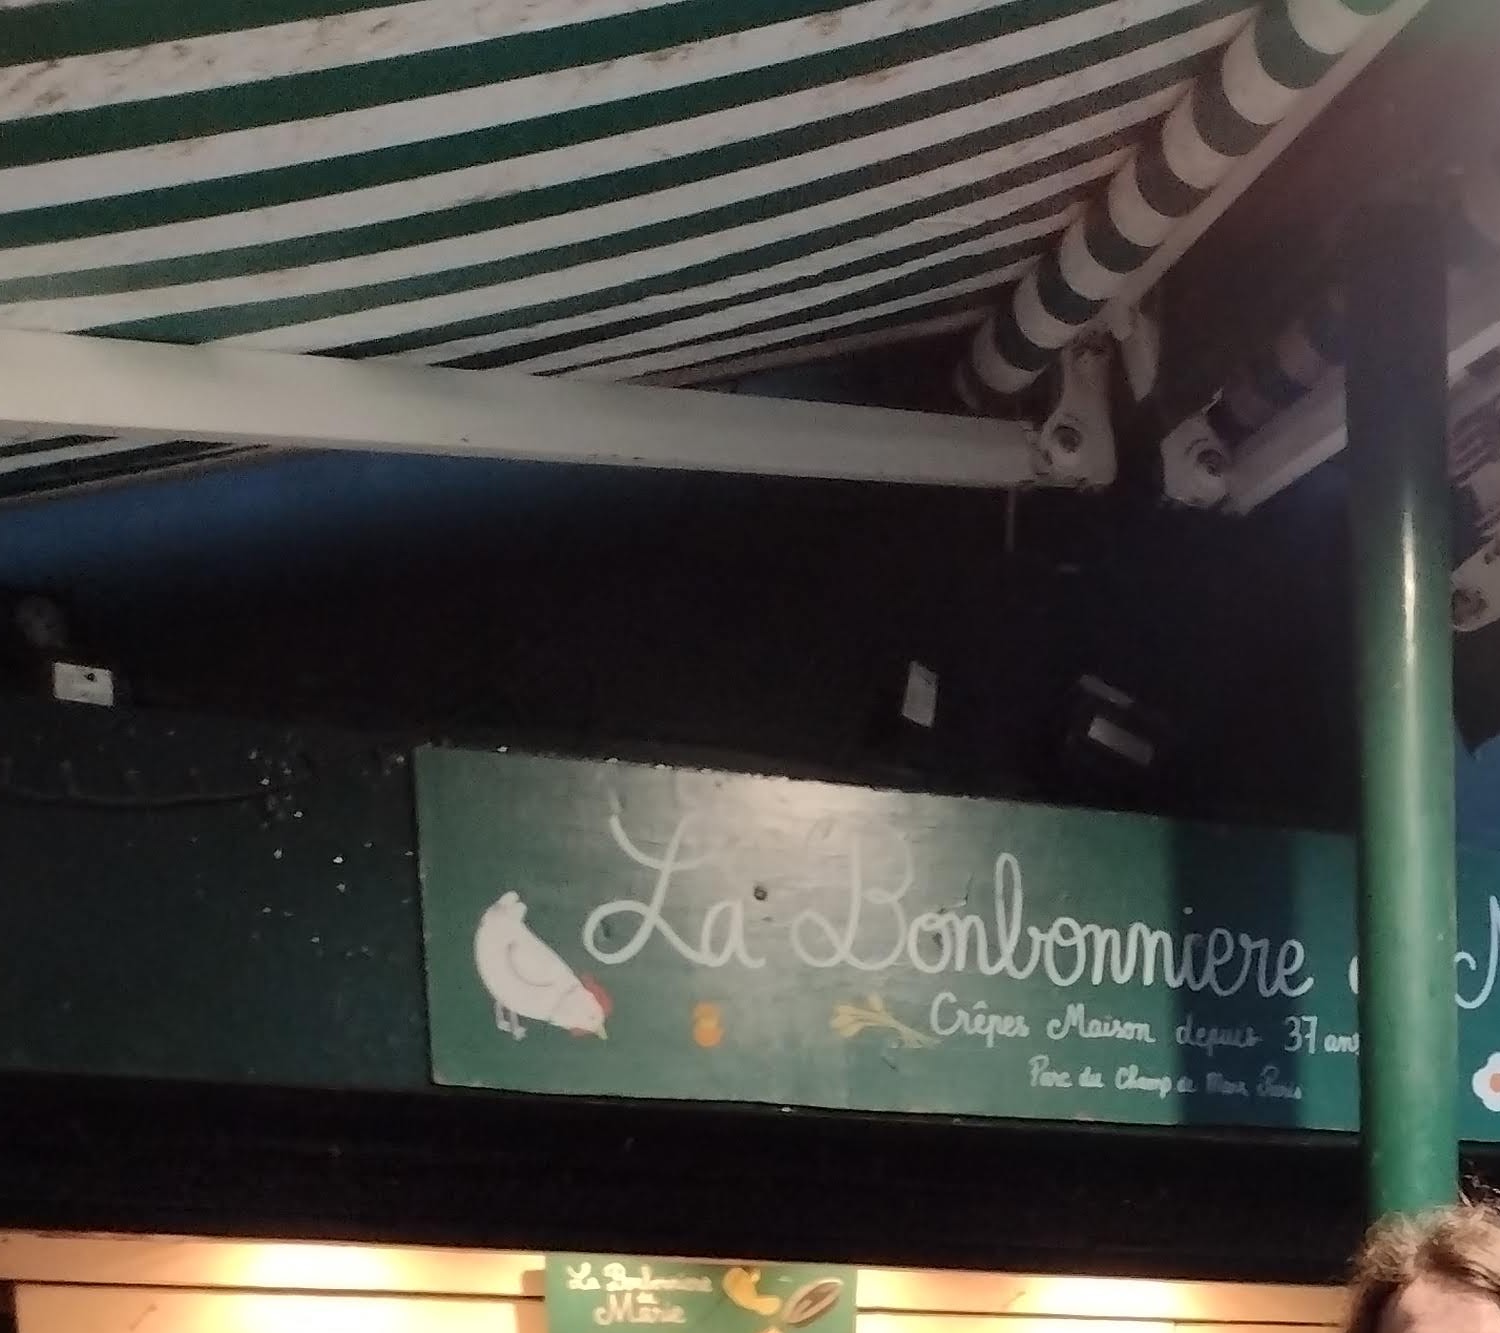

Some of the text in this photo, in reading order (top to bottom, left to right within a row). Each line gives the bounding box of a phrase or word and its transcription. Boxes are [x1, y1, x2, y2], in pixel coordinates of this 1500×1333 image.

[583, 788, 766, 968] La
[791, 812, 1314, 998] Bonbonniere
[930, 991, 1030, 1048] Crêpes
[1046, 1002, 1156, 1043] Maison
[1284, 1015, 1318, 1054] 37
